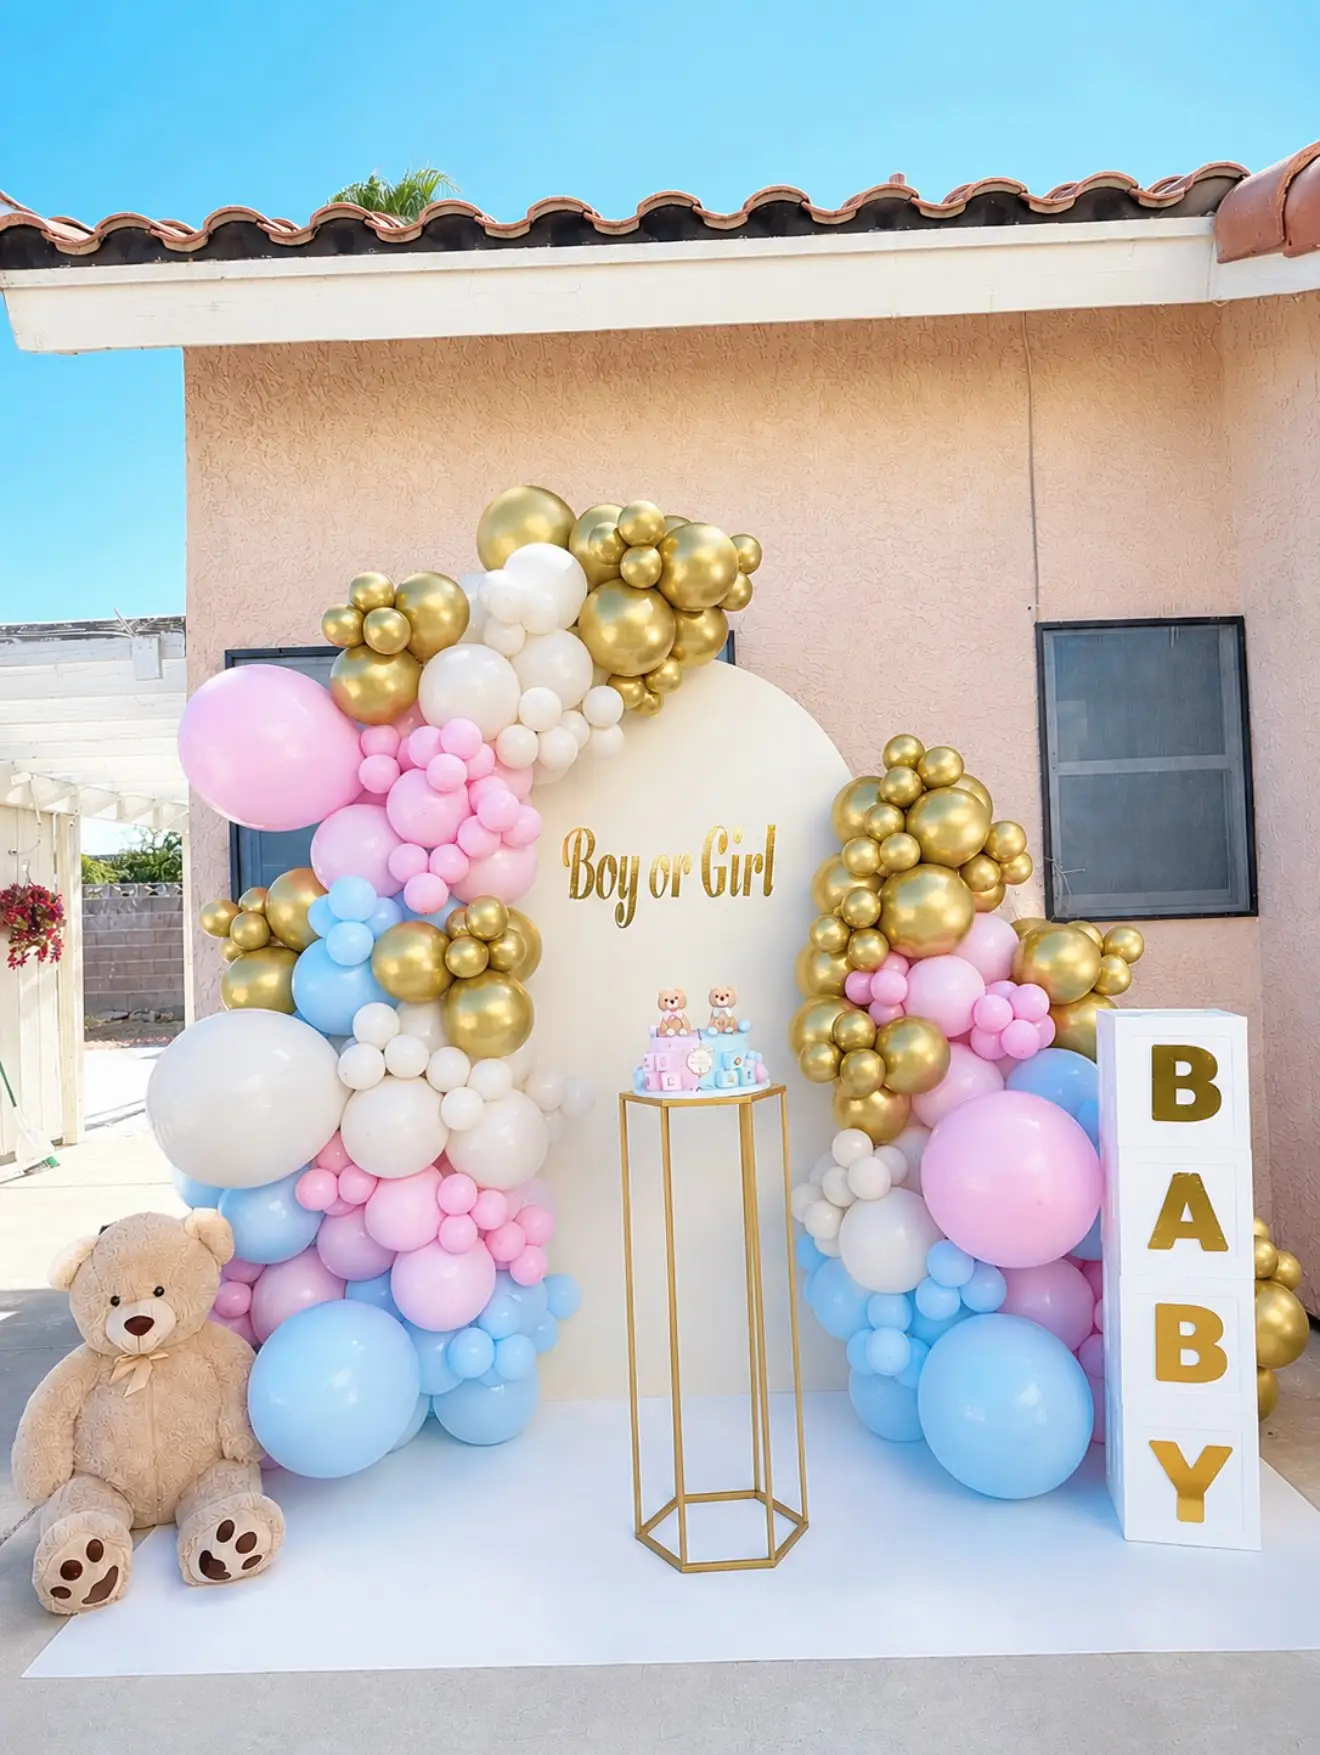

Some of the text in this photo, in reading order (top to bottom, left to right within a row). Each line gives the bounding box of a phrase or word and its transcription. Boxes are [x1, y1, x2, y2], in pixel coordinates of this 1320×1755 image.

[562, 823, 776, 929] Boy or Girl
[1148, 1044, 1233, 1524] BABY
